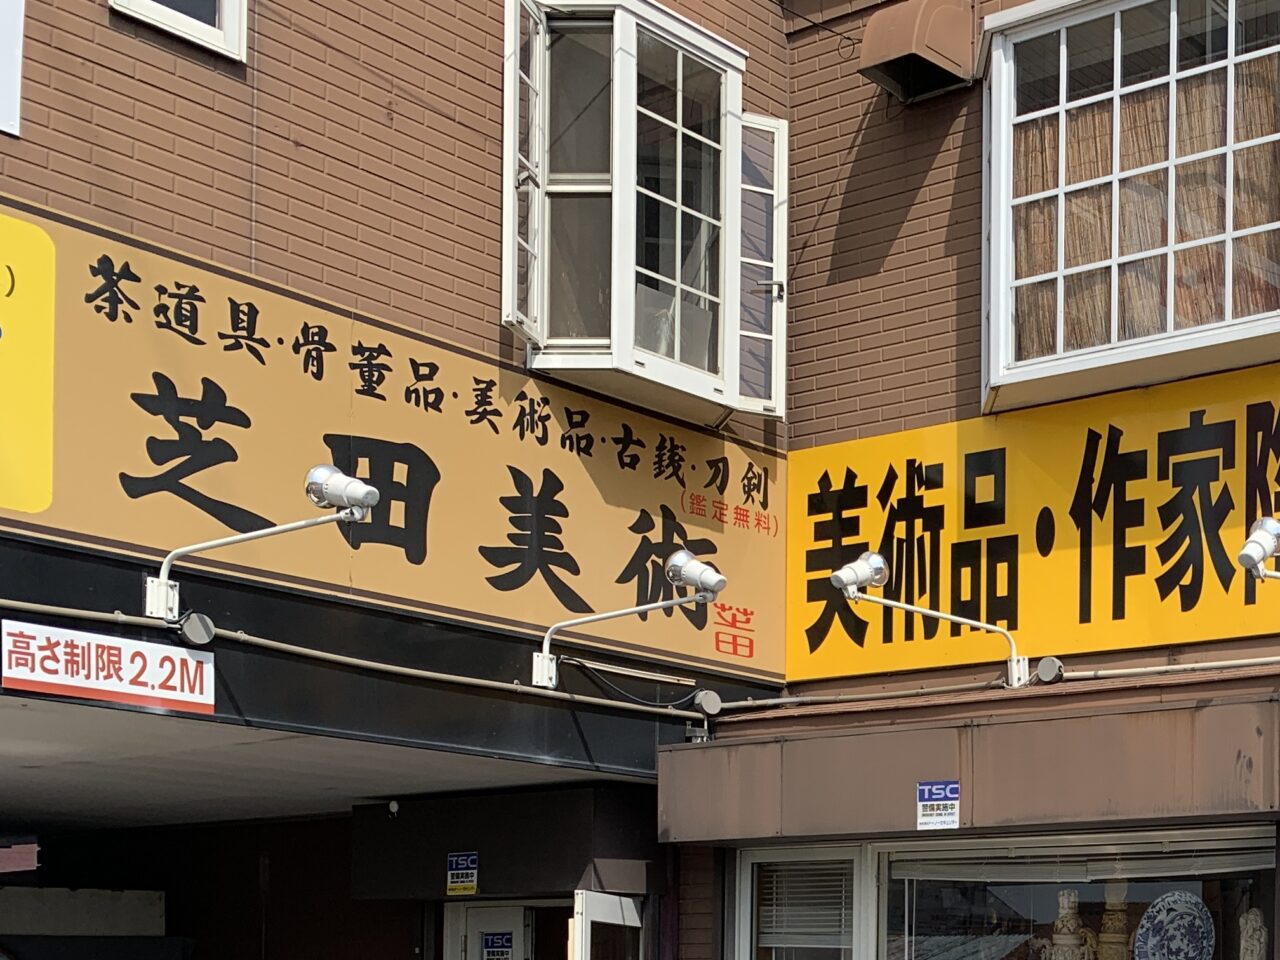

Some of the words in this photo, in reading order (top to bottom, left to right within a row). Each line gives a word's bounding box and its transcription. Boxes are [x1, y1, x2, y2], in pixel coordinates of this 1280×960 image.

[118, 372, 721, 631] 芝田美術
[680, 489, 779, 538] (鑑定無料)
[918, 784, 959, 799] TSC
[448, 855, 477, 869] TSC
[485, 935, 512, 947] TSC
